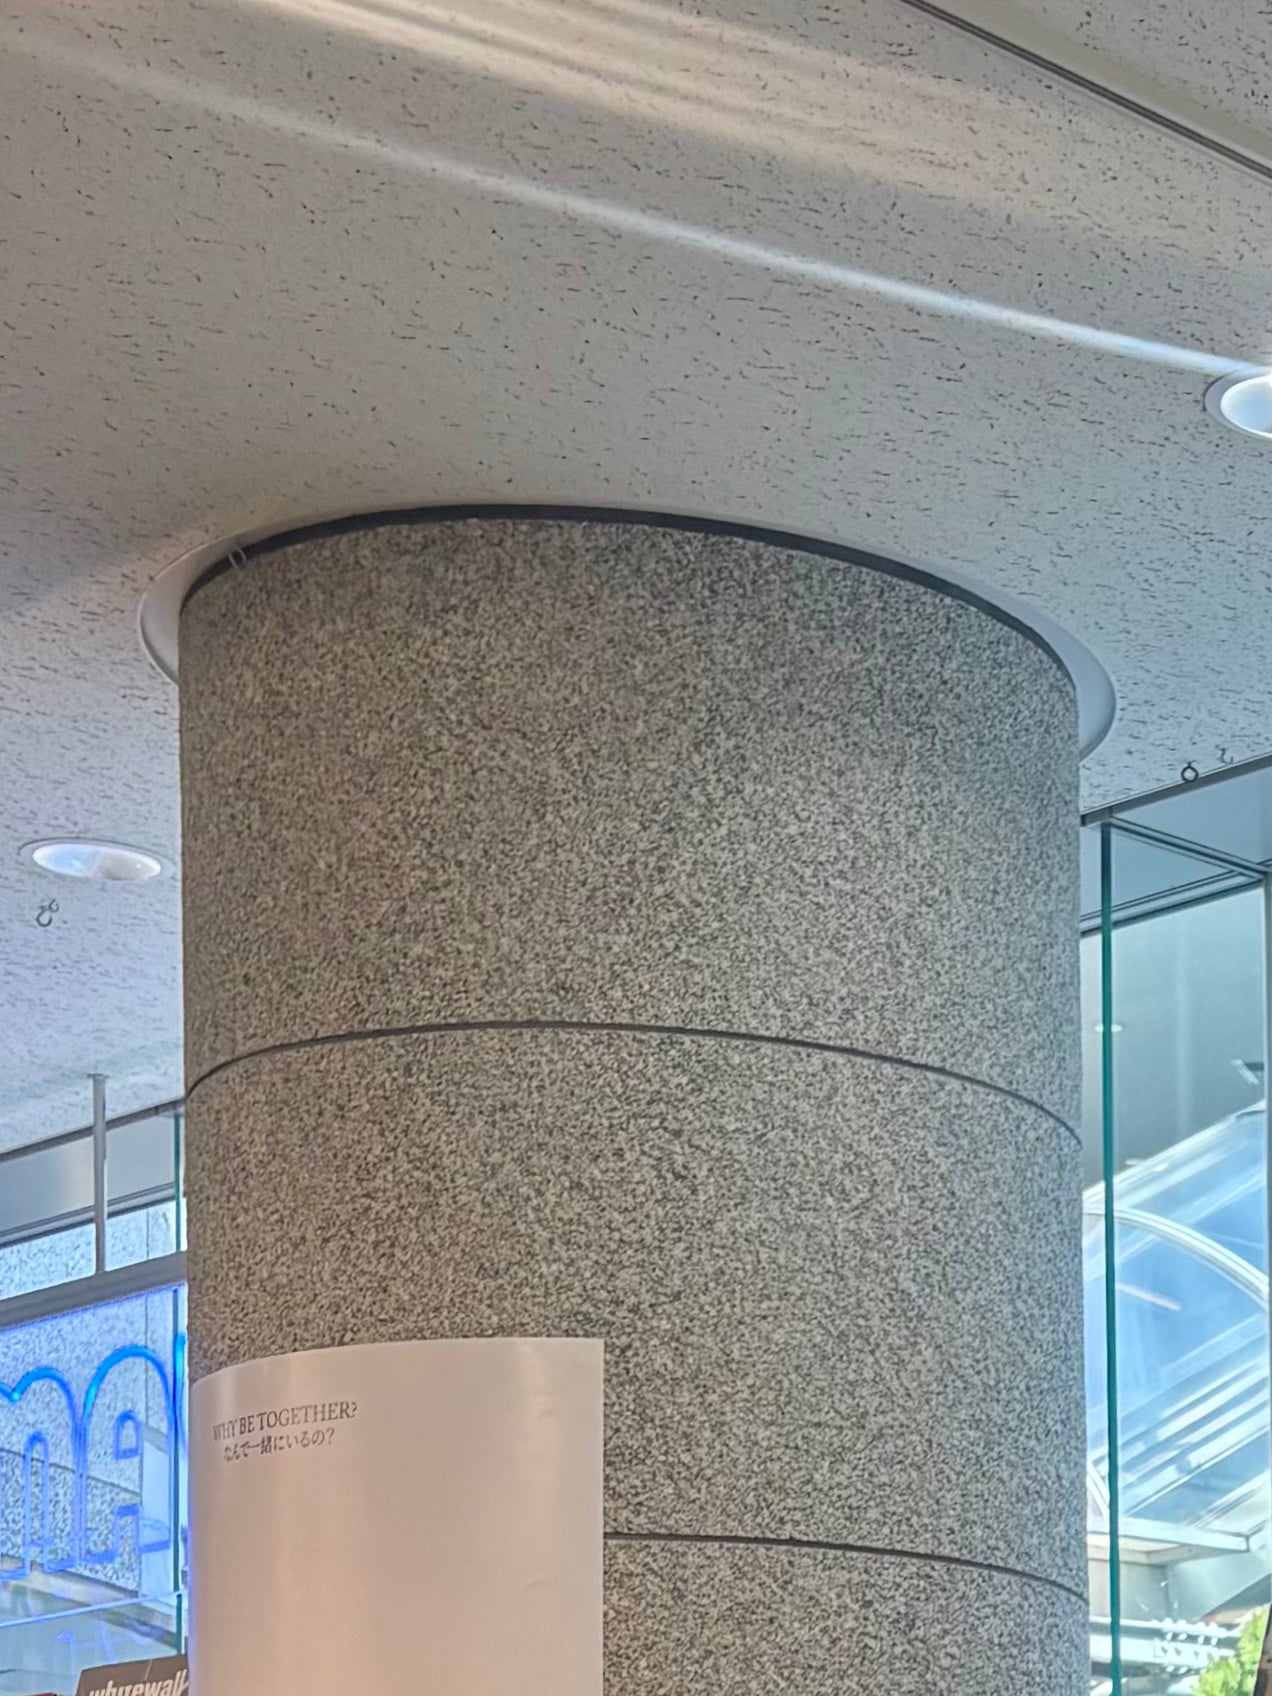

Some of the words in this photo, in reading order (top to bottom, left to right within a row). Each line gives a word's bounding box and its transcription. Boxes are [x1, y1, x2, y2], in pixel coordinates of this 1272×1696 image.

[213, 1418, 239, 1442] WHY
[239, 1415, 255, 1435] BE
[257, 1401, 358, 1431] TOGETHER?
